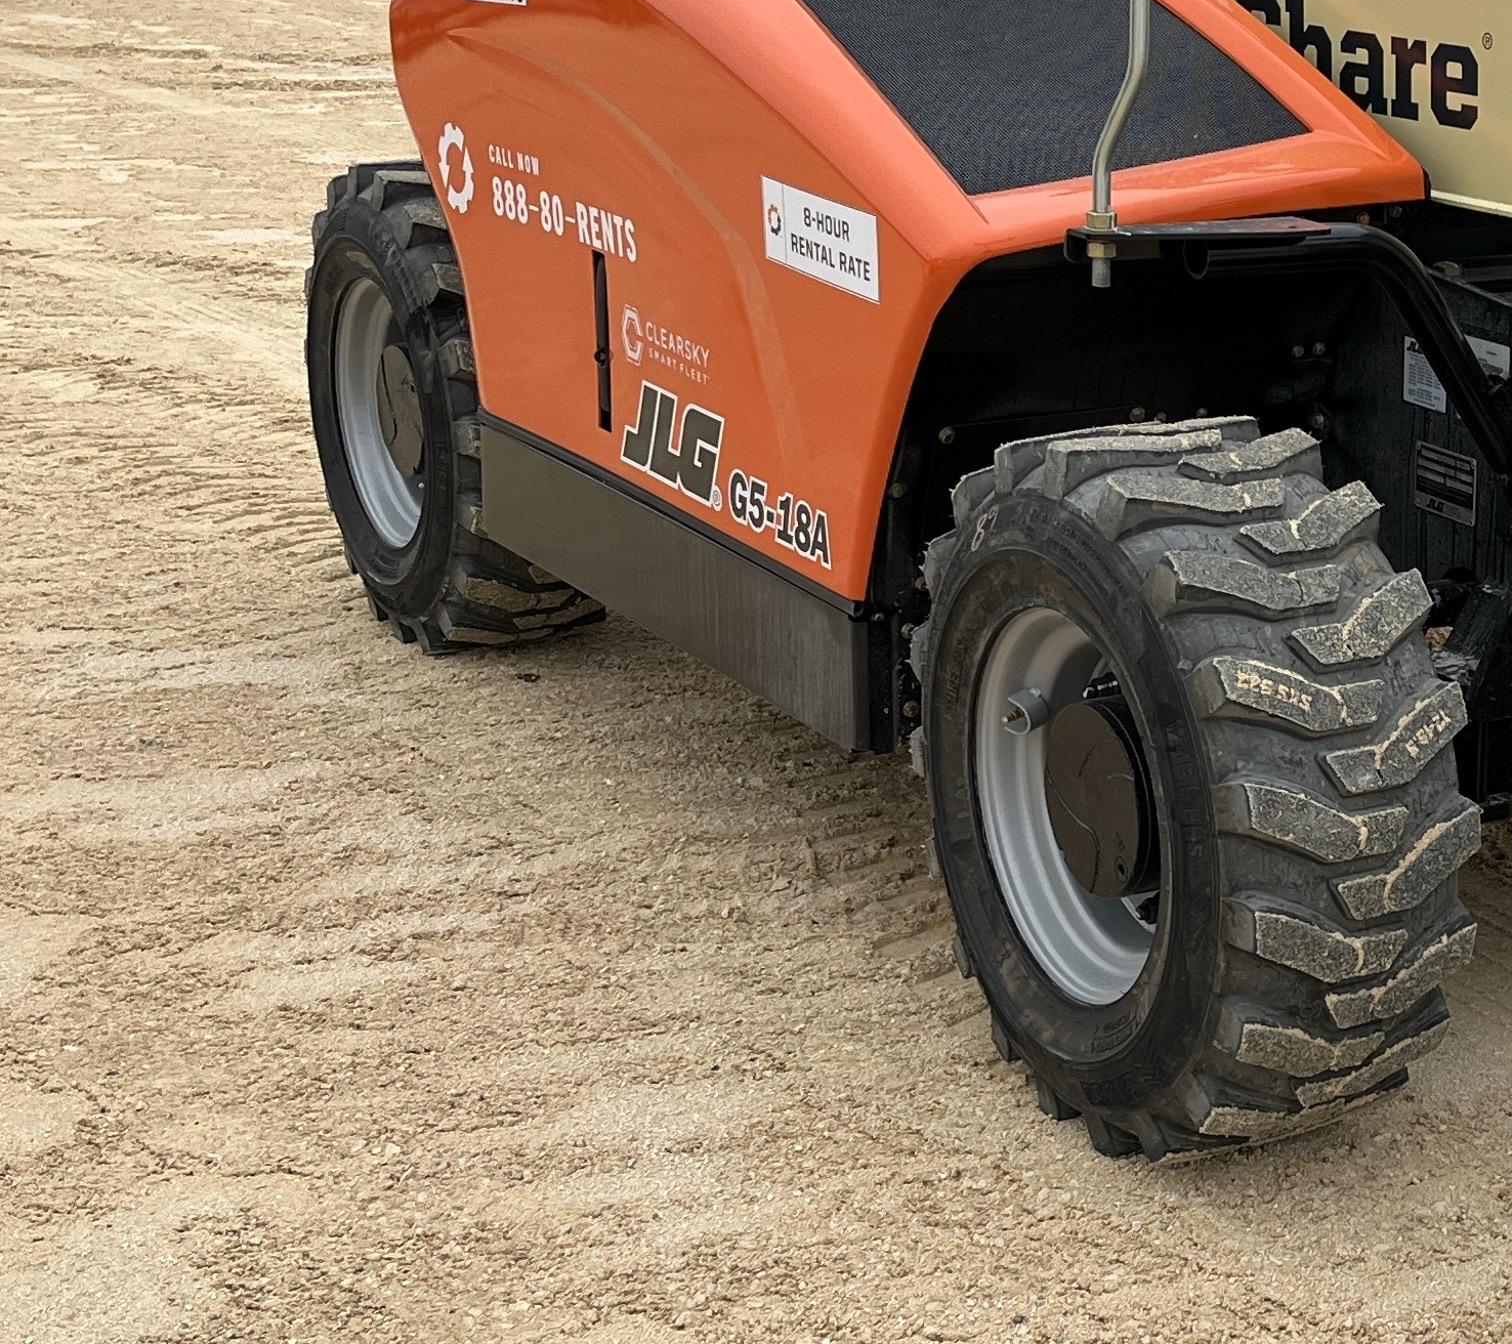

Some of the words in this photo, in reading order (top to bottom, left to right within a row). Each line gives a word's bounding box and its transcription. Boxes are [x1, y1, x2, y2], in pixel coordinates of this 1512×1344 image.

[488, 144, 514, 169] CALL
[517, 152, 540, 176] NOW
[492, 176, 637, 263] 888-80-RENTS
[803, 207, 850, 242] 8-HOUR
[790, 232, 836, 268] RENTAL
[838, 251, 871, 282] RATE
[645, 321, 710, 369] CLEARSKY
[648, 347, 677, 370] SMART
[680, 362, 708, 385] FLEET
[620, 379, 725, 507] JLG
[728, 468, 832, 570] G5-18A
